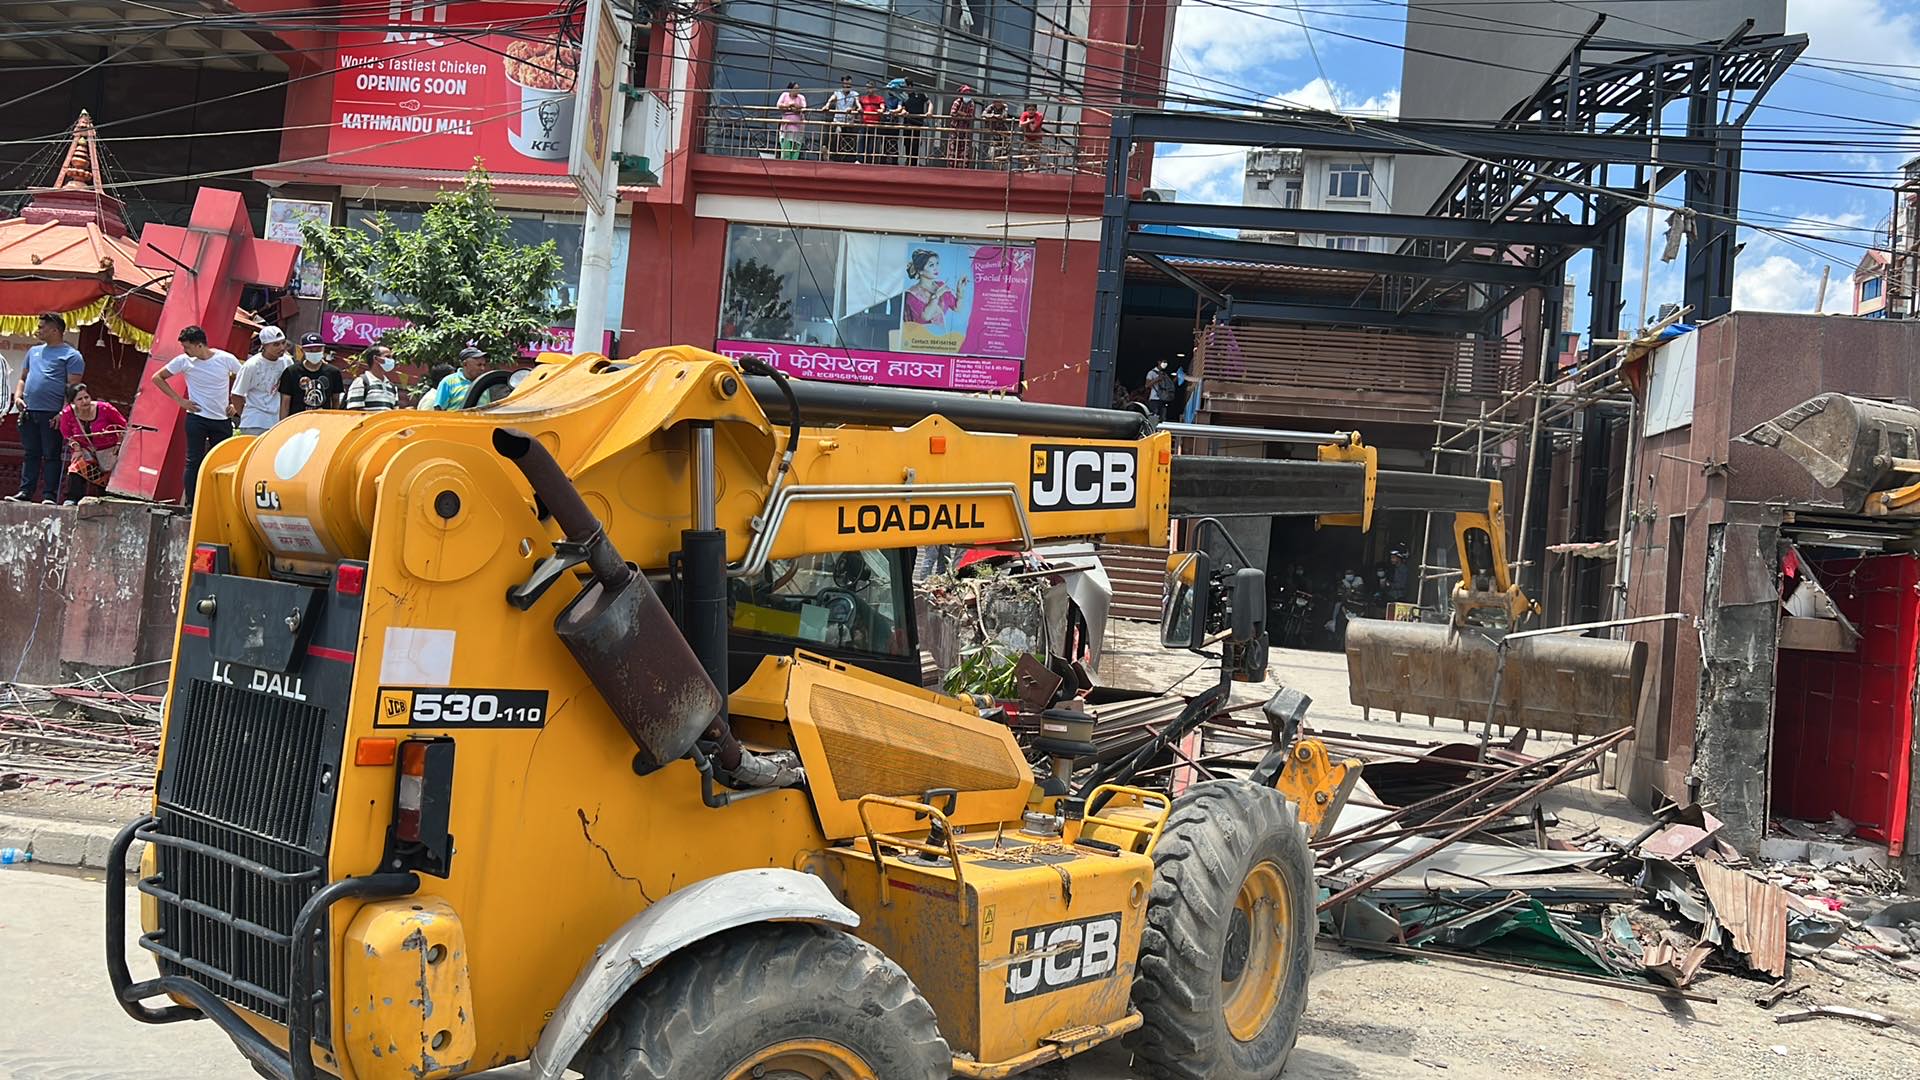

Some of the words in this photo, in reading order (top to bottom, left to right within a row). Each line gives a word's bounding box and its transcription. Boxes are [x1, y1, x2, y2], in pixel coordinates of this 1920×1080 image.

[341, 55, 385, 70] World's
[389, 58, 436, 72] Tastiest
[440, 60, 487, 75] Chicken
[356, 74, 421, 93] OPENING
[424, 78, 466, 95] SOON
[342, 113, 433, 133] KATHMANDU
[436, 118, 473, 135] MALL
[531, 140, 560, 151] KFC
[790, 349, 881, 374] फेसियल
[888, 360, 945, 379] हाउस
[1032, 450, 1136, 507] JCB
[837, 503, 985, 535] LOADALL
[388, 699, 408, 716] JCB
[413, 693, 541, 722] 530-110
[1009, 919, 1118, 995] JCB
